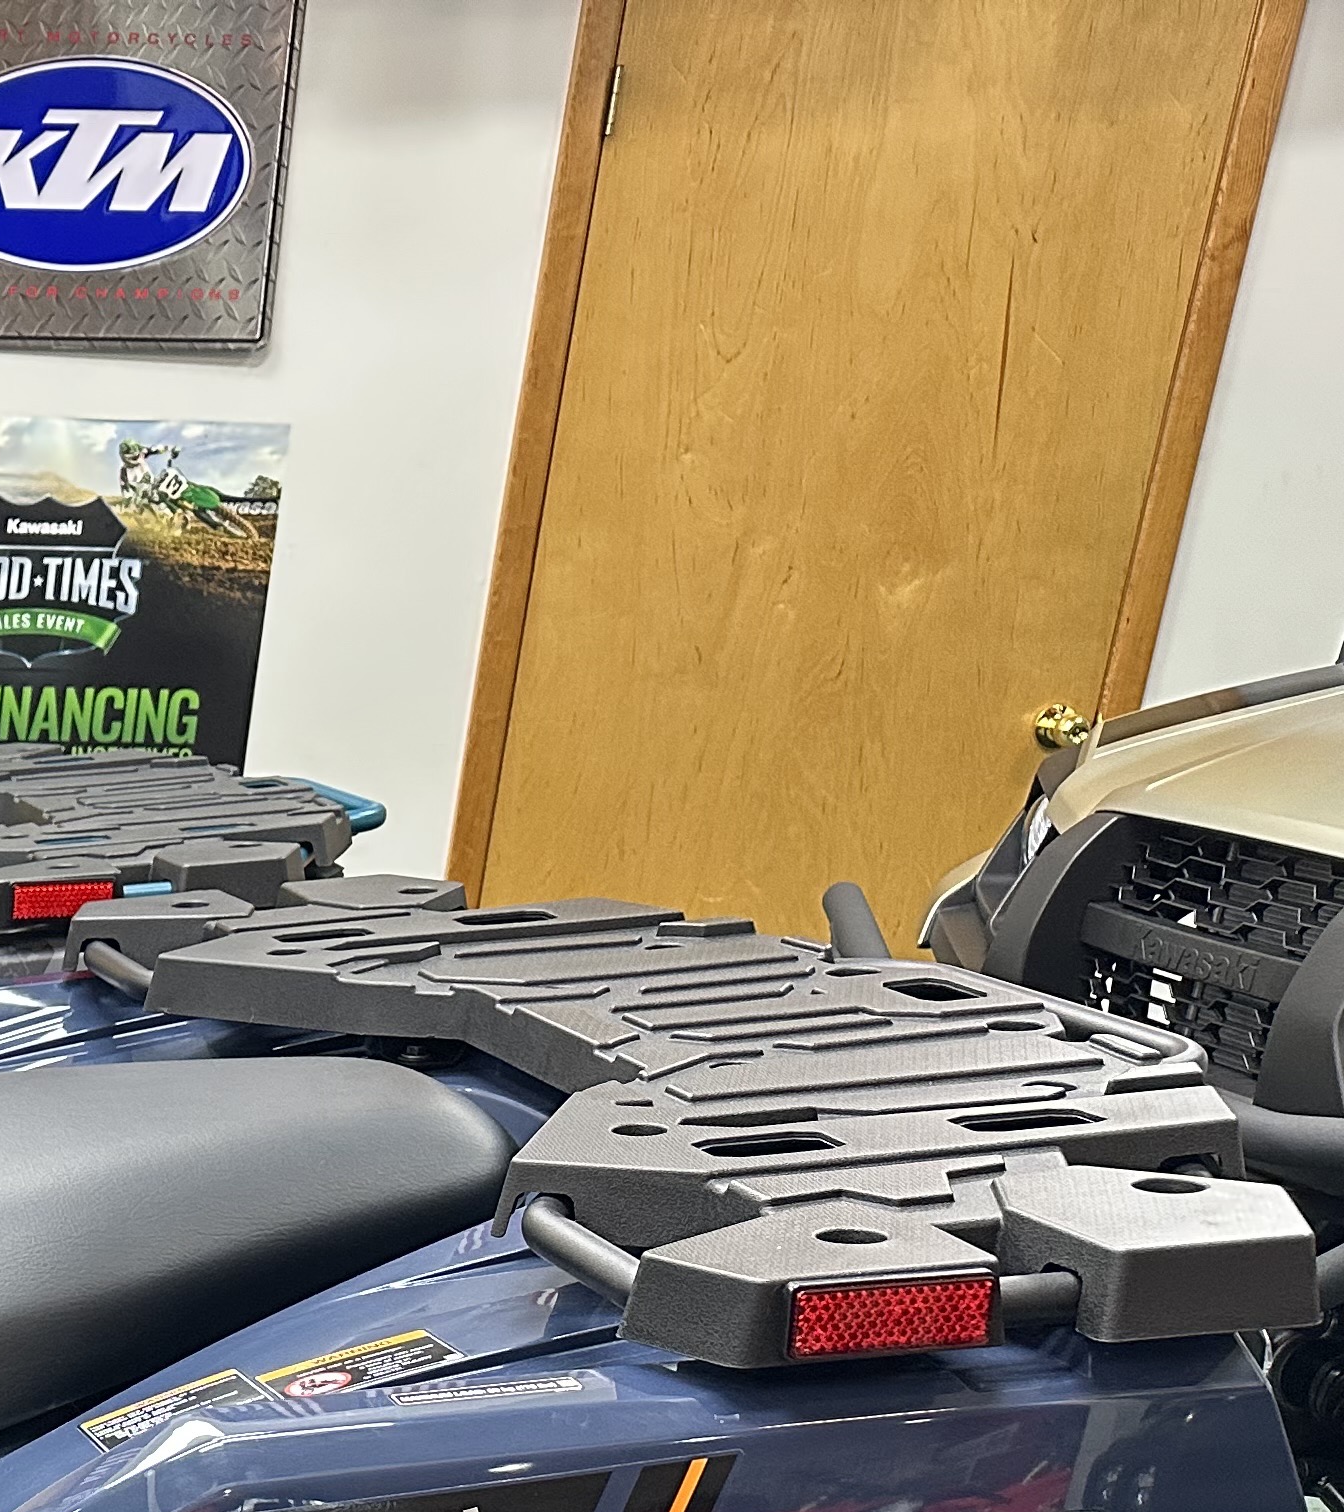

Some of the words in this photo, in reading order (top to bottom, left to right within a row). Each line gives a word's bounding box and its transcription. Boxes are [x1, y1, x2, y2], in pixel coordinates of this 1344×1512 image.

[47, 28, 253, 48] MOTORCYCLES
[8, 286, 58, 298] FOR
[7, 518, 84, 536] Kawasaki
[42, 556, 142, 615] TIMES
[36, 613, 86, 634] EVENT
[1134, 928, 1262, 993] Kawasaki
